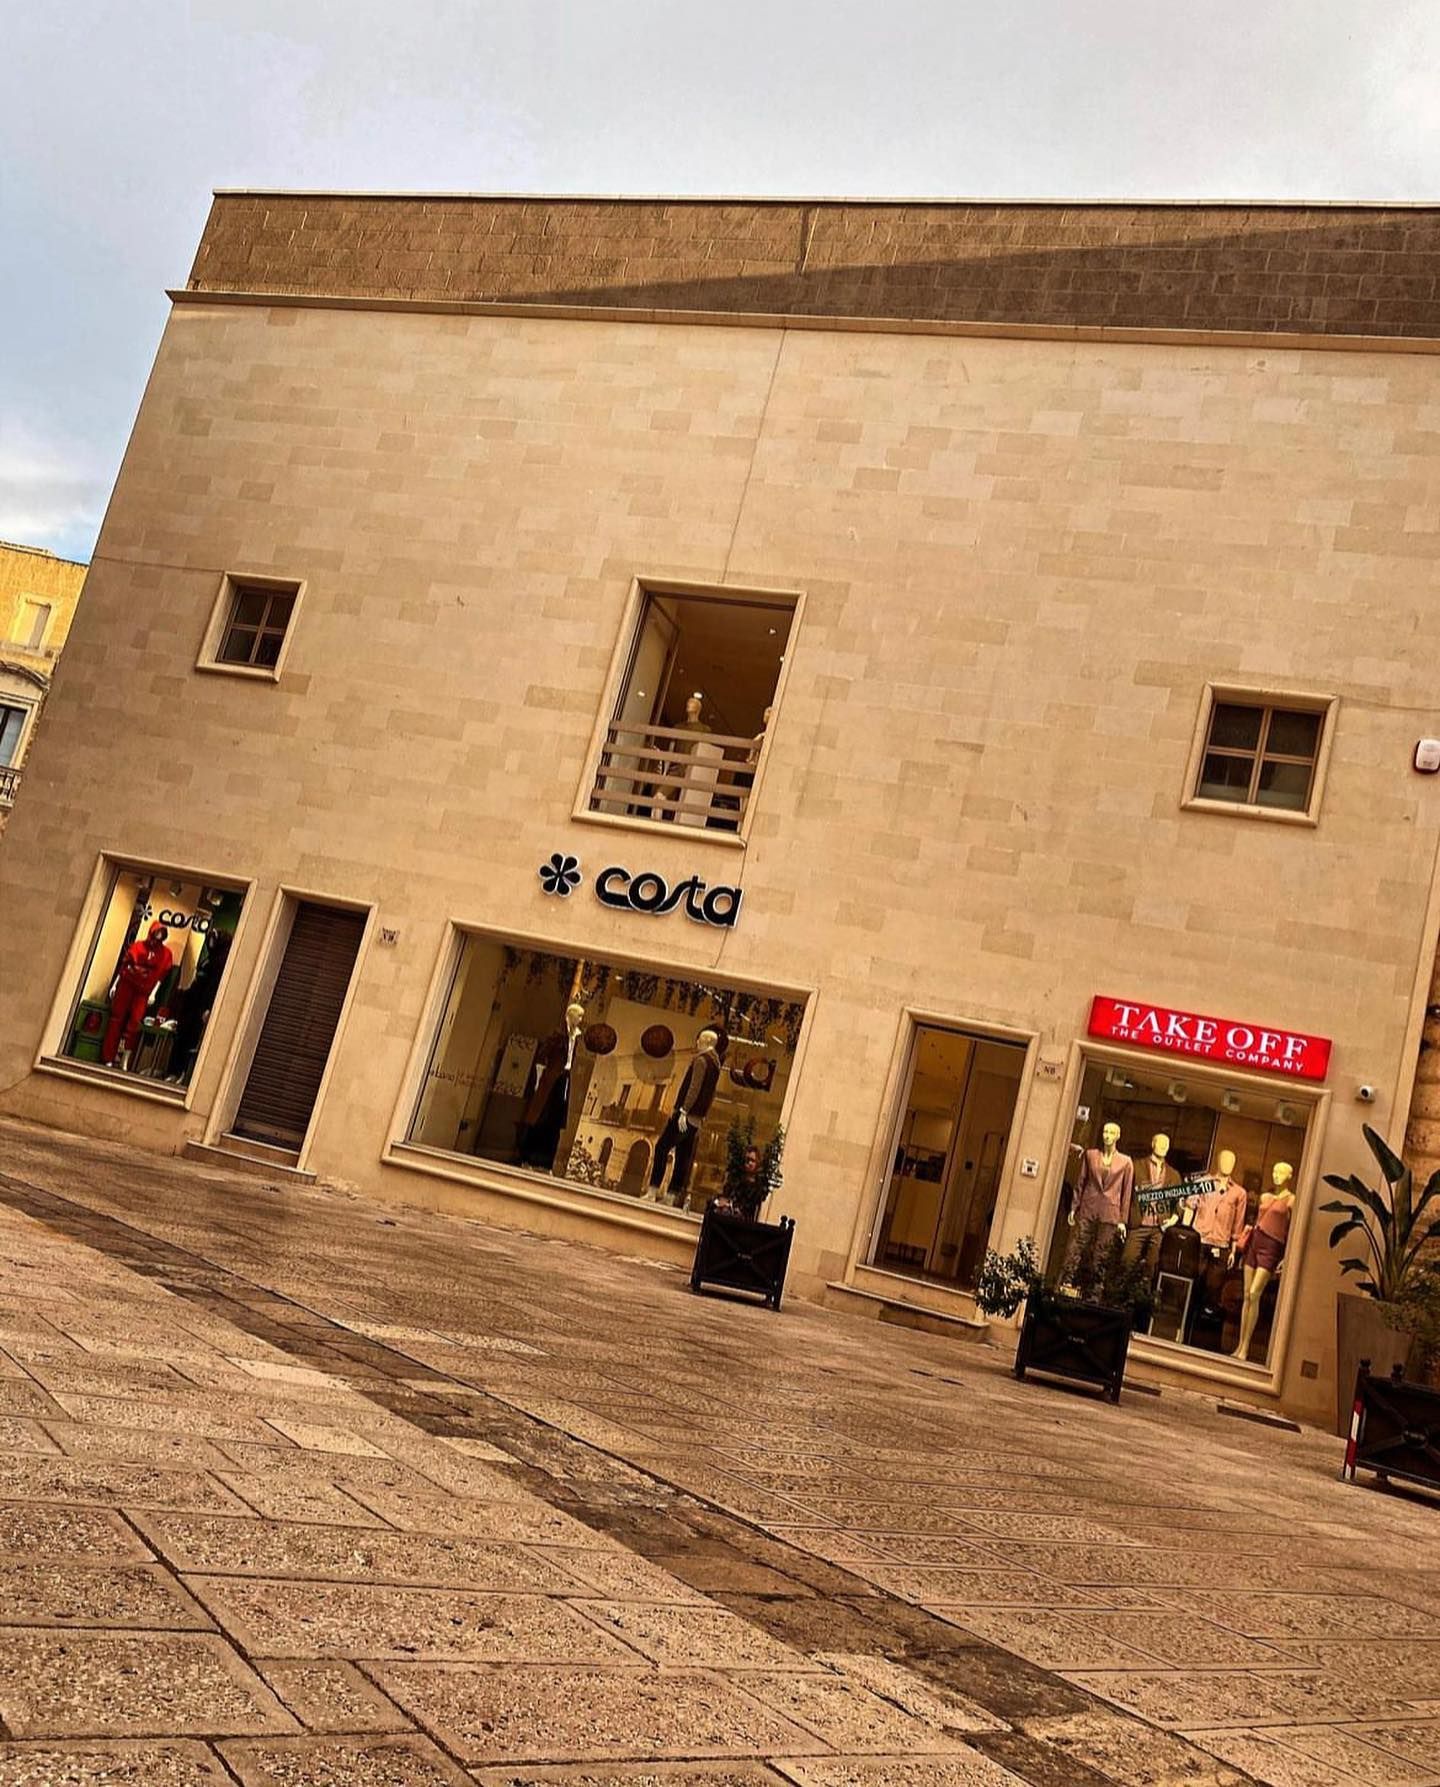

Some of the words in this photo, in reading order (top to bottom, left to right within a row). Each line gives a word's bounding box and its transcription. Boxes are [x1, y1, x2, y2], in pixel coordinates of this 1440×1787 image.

[594, 865, 744, 928] costa
[1111, 1025, 1139, 1040] THE
[1152, 1035, 1212, 1054] OUTLET
[1226, 1048, 1304, 1072] COMPANY
[1113, 1003, 1217, 1043] TAKE
[1226, 1026, 1308, 1060] OFF
